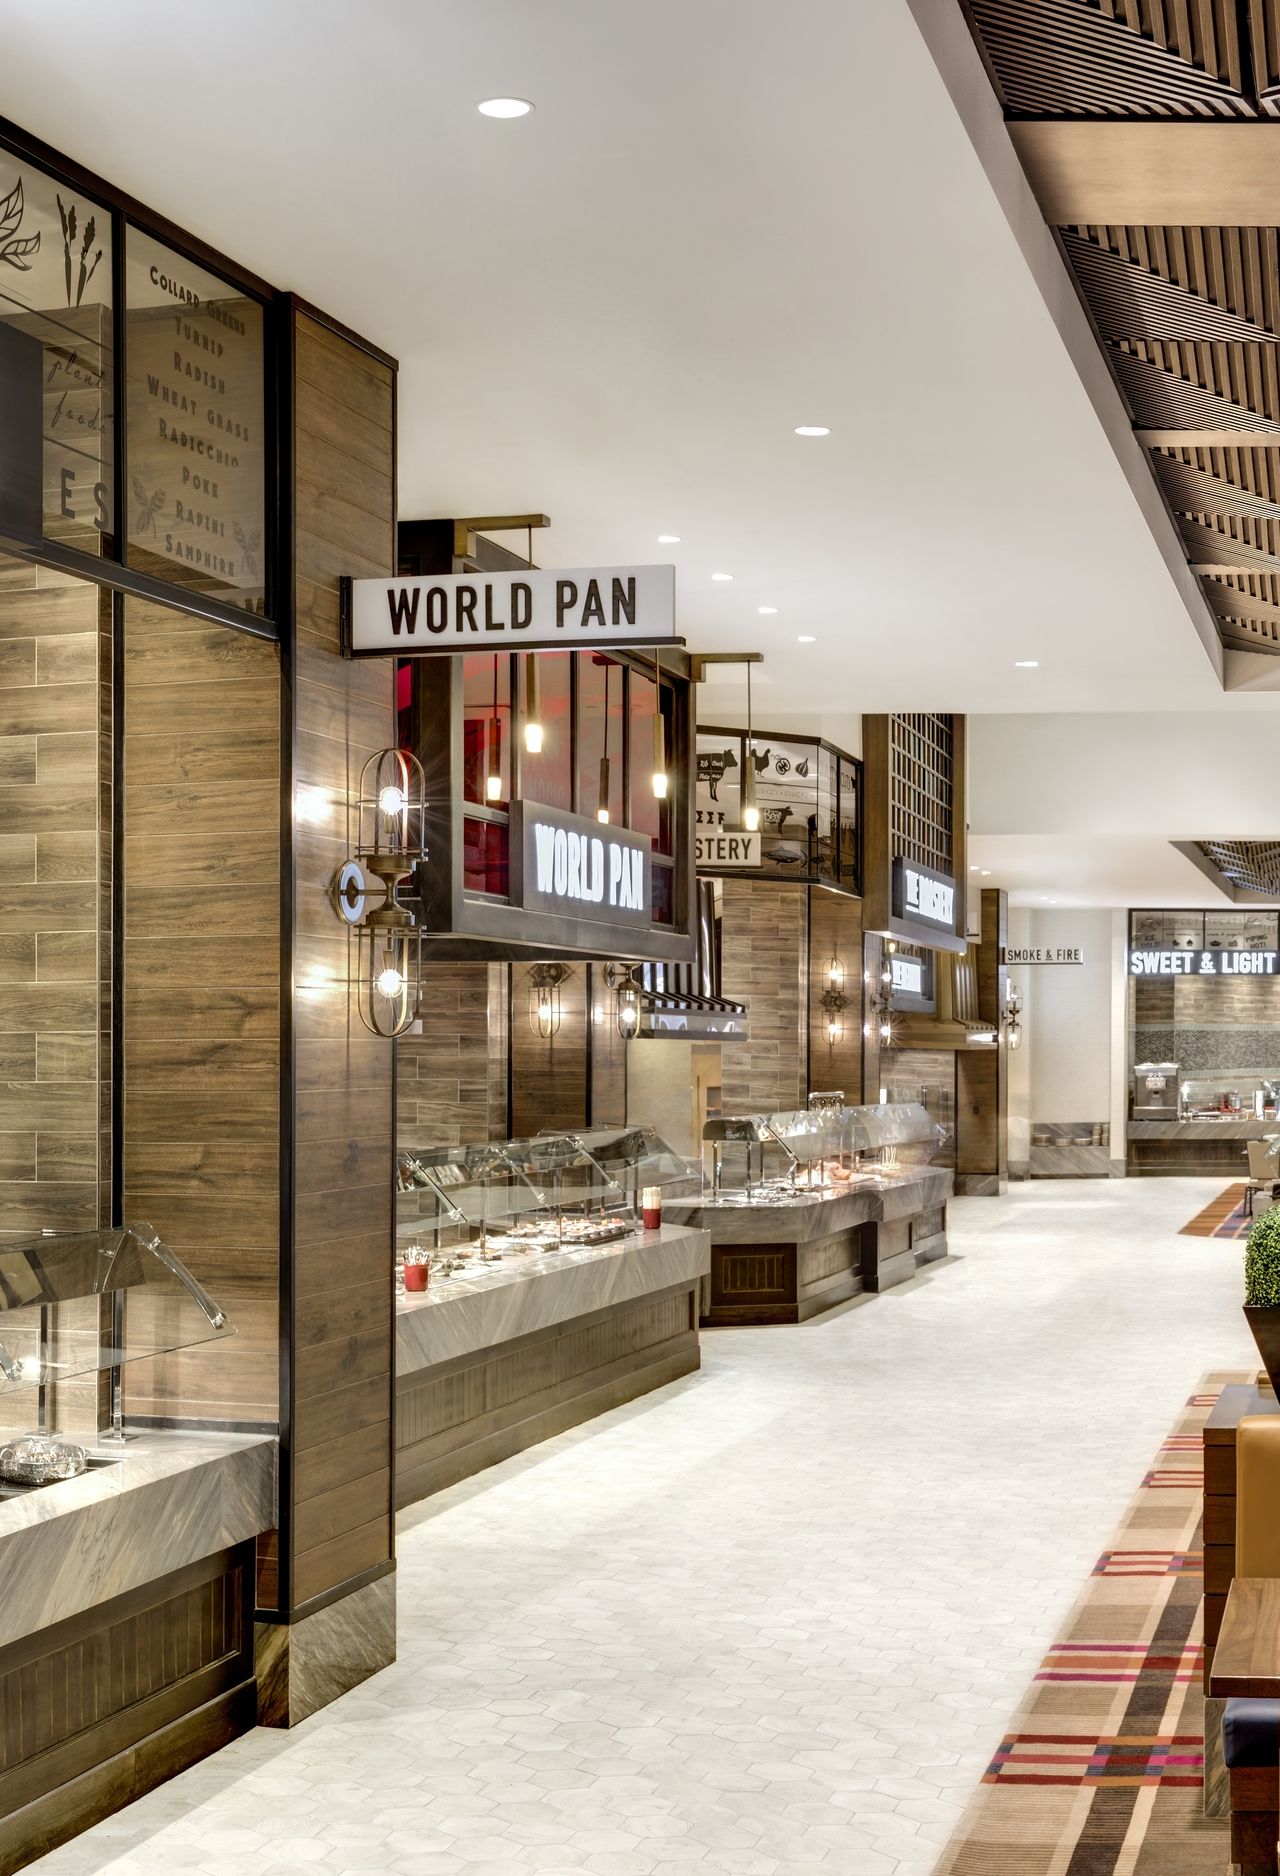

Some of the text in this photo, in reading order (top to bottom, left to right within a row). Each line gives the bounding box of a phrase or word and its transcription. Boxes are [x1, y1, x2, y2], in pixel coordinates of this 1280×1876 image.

[387, 577, 637, 635] WORLD PAN
[534, 823, 644, 911] WORLD PAN
[1007, 949, 1079, 961] SMOKE & FIRE
[1131, 951, 1277, 974] SWEET & LIGHT
